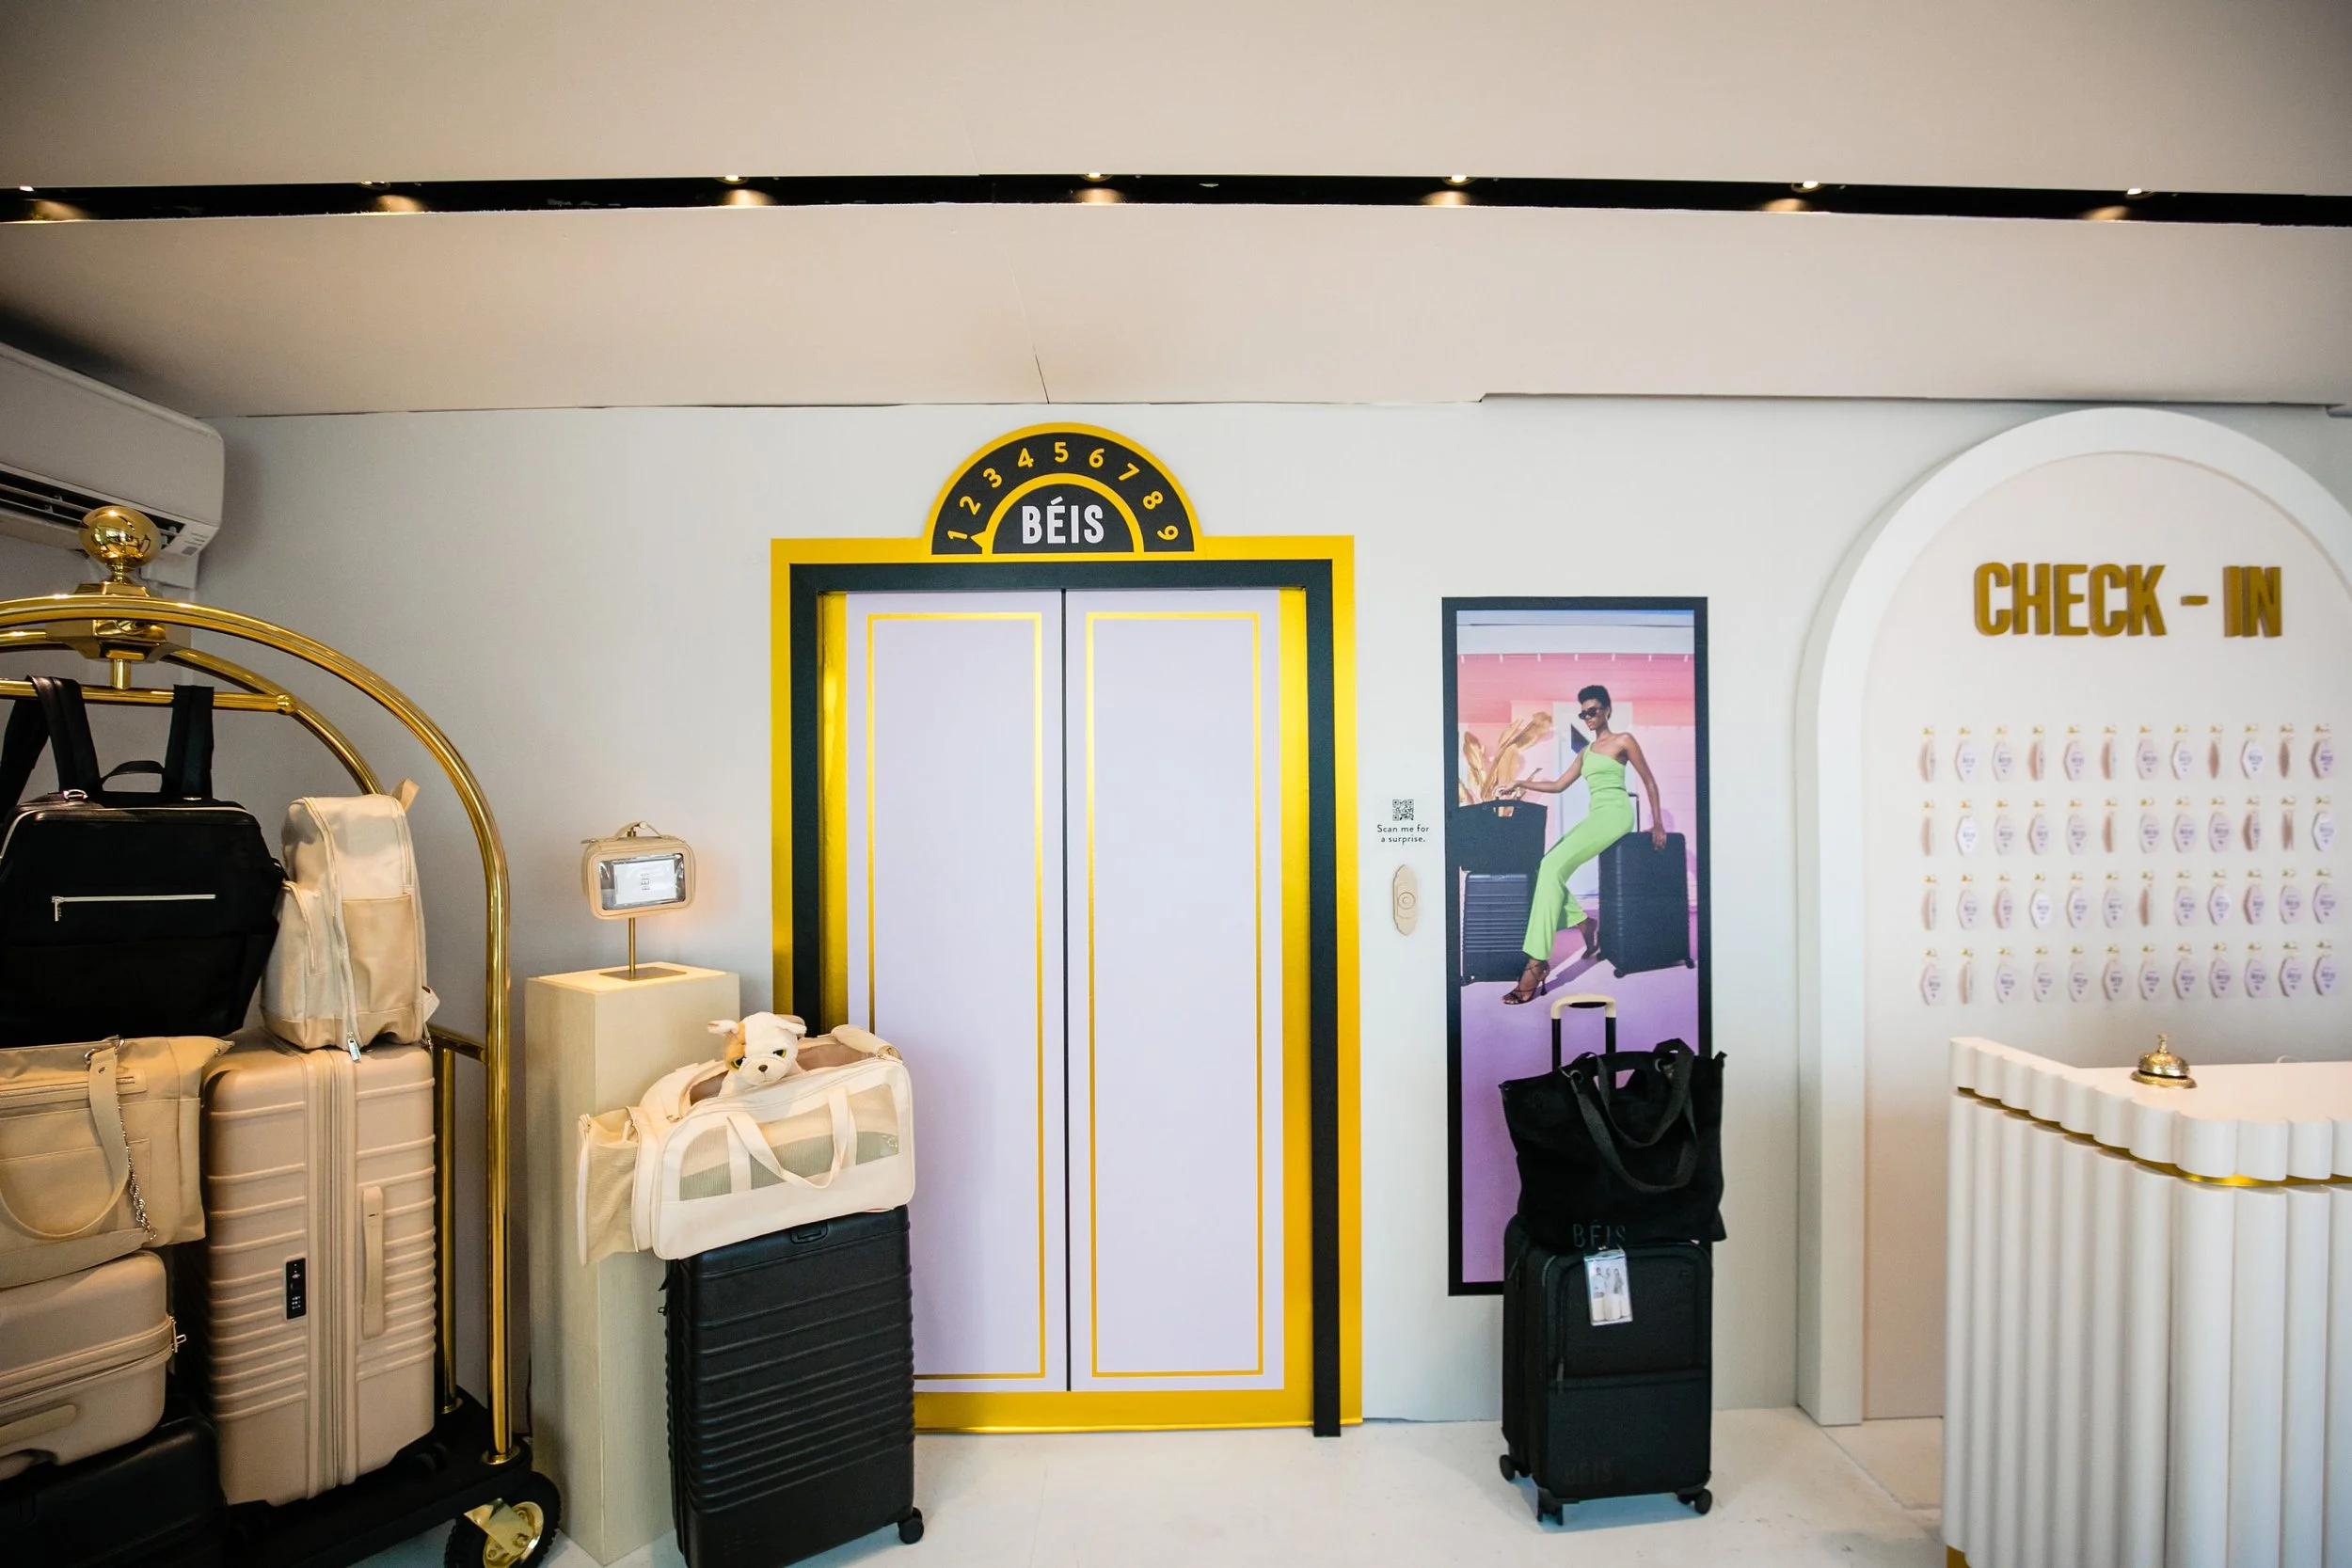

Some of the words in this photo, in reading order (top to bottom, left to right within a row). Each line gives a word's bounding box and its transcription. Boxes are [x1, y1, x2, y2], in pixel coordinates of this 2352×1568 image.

[947, 530, 968, 540] 1
[960, 496, 981, 515] 2
[983, 467, 1003, 488] 3
[1017, 448, 1034, 467] 4
[1054, 442, 1069, 463] 5
[1089, 448, 1104, 467] 6
[1118, 463, 1140, 481] 7
[1142, 490, 1164, 510] 8
[1157, 525, 1179, 541] 9
[1022, 496, 1104, 545] BÉIS
[1974, 562, 2168, 637] CHECK
[2222, 565, 2282, 638] IN
[1376, 824, 1398, 833] Scan
[1417, 824, 1429, 833] for
[1388, 835, 1426, 845] surprise.
